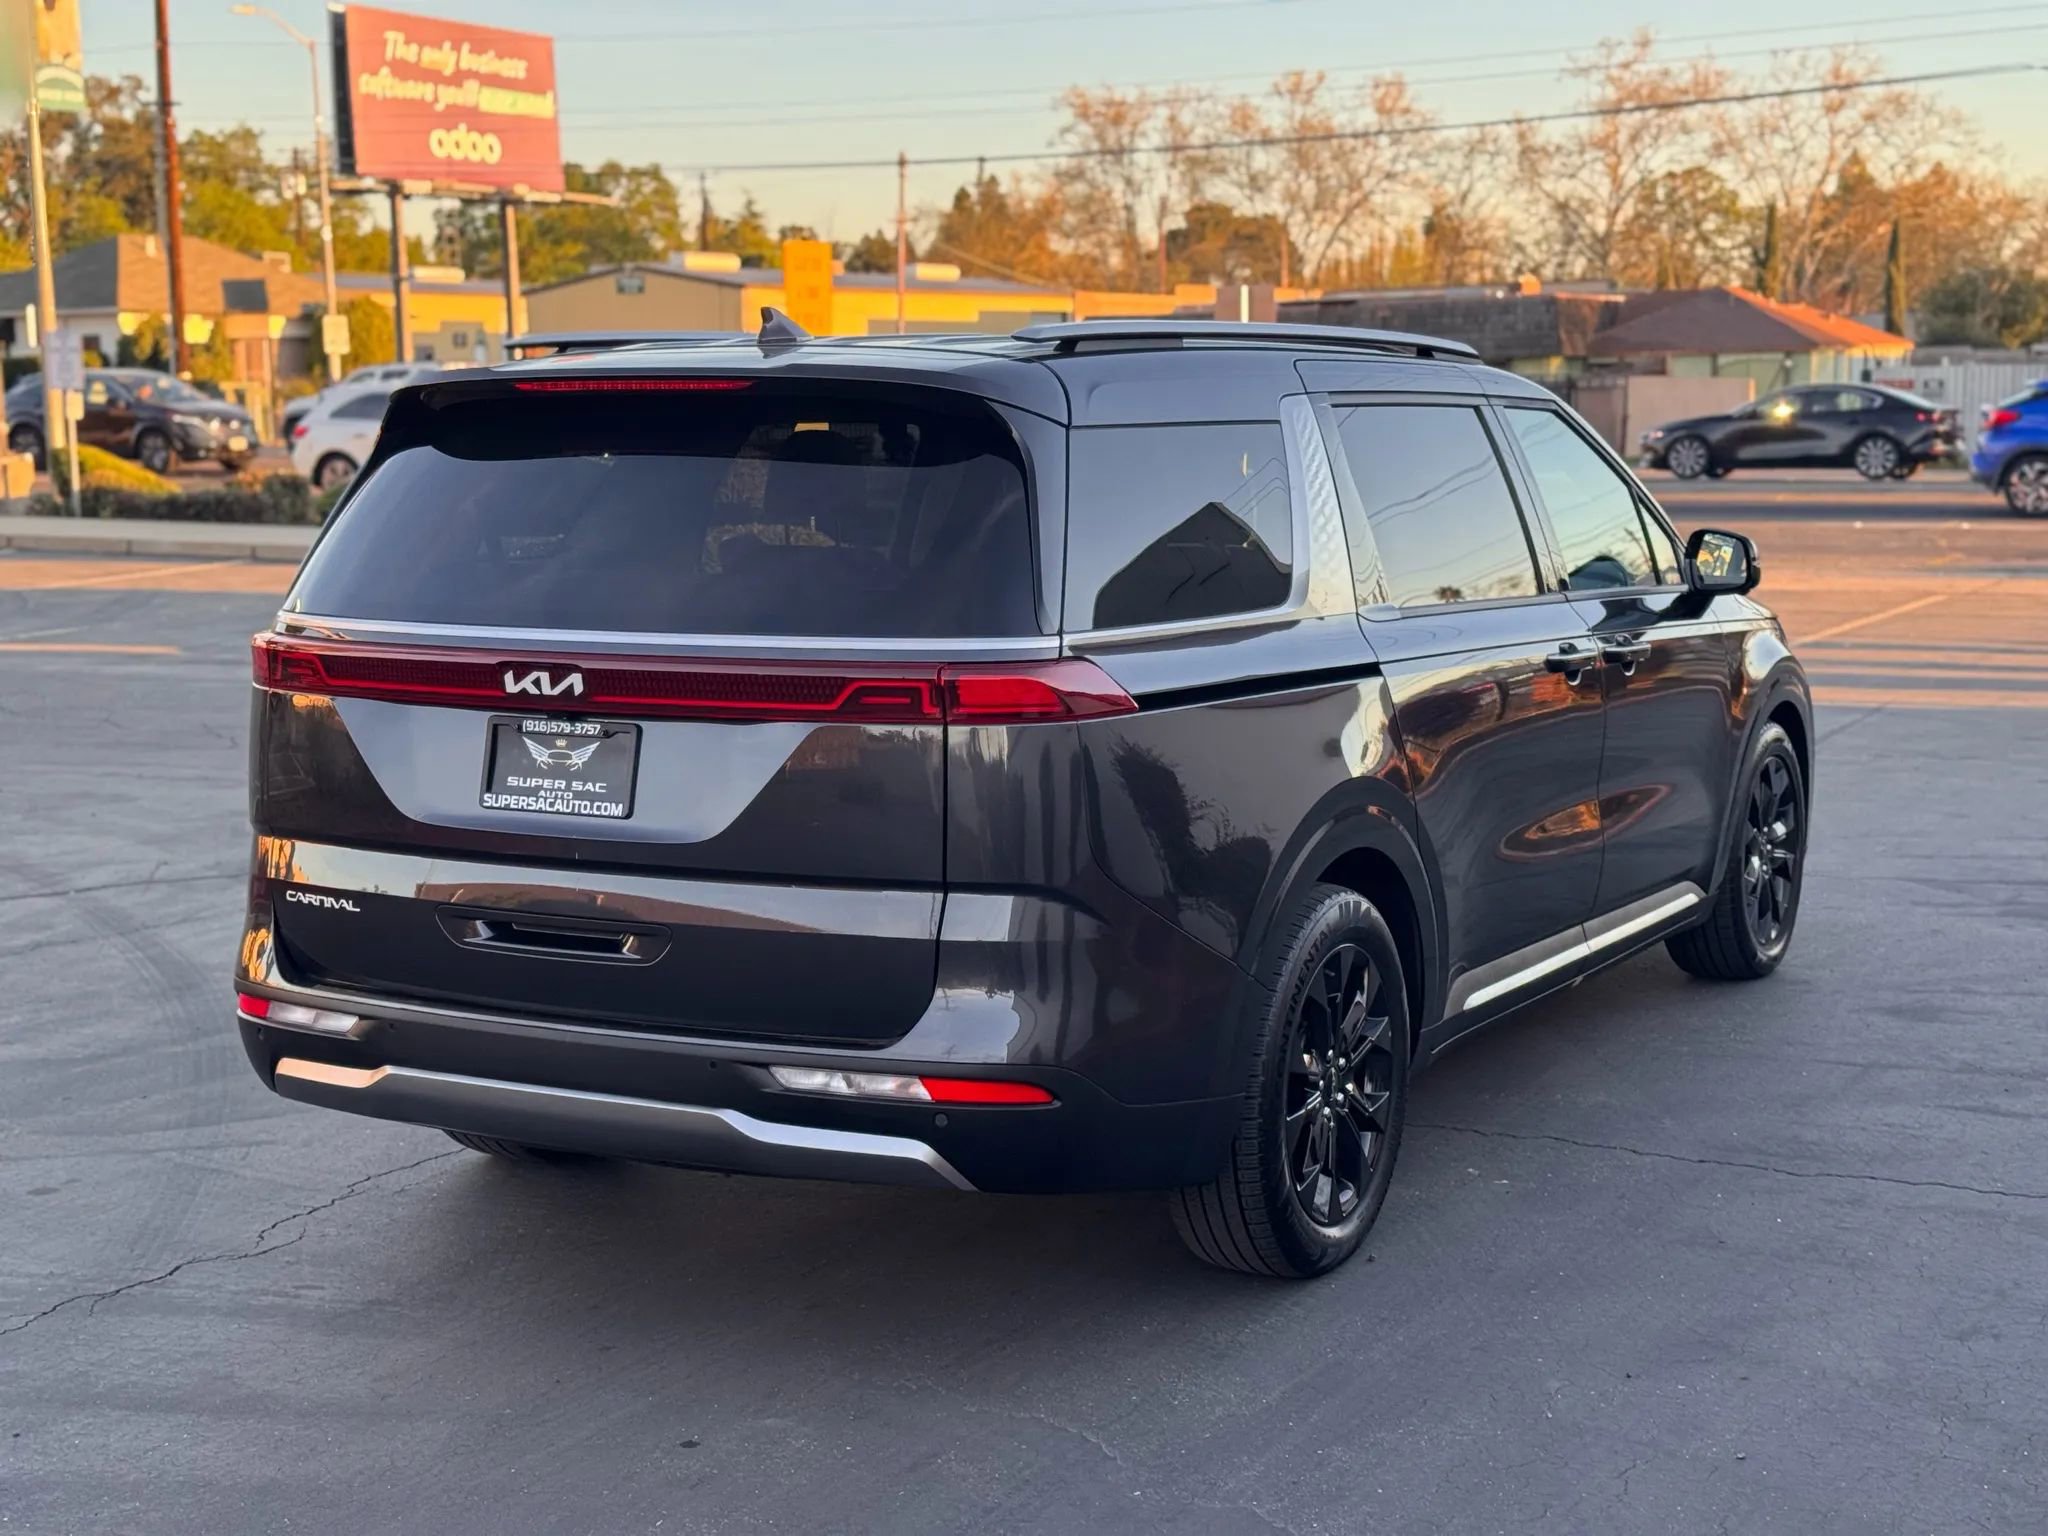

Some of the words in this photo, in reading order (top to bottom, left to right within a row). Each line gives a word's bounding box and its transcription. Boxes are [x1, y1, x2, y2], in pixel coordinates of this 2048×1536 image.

[383, 30, 419, 62] The
[429, 123, 502, 164] odoo
[504, 670, 584, 696] KIA
[522, 720, 601, 735] (916)579-3757
[507, 776, 566, 790] SUPER
[571, 781, 607, 793] SAC
[537, 790, 573, 799] AUTO
[483, 793, 624, 817] SUPERSACAUTO.COM
[286, 890, 361, 912] CARNIVAL
